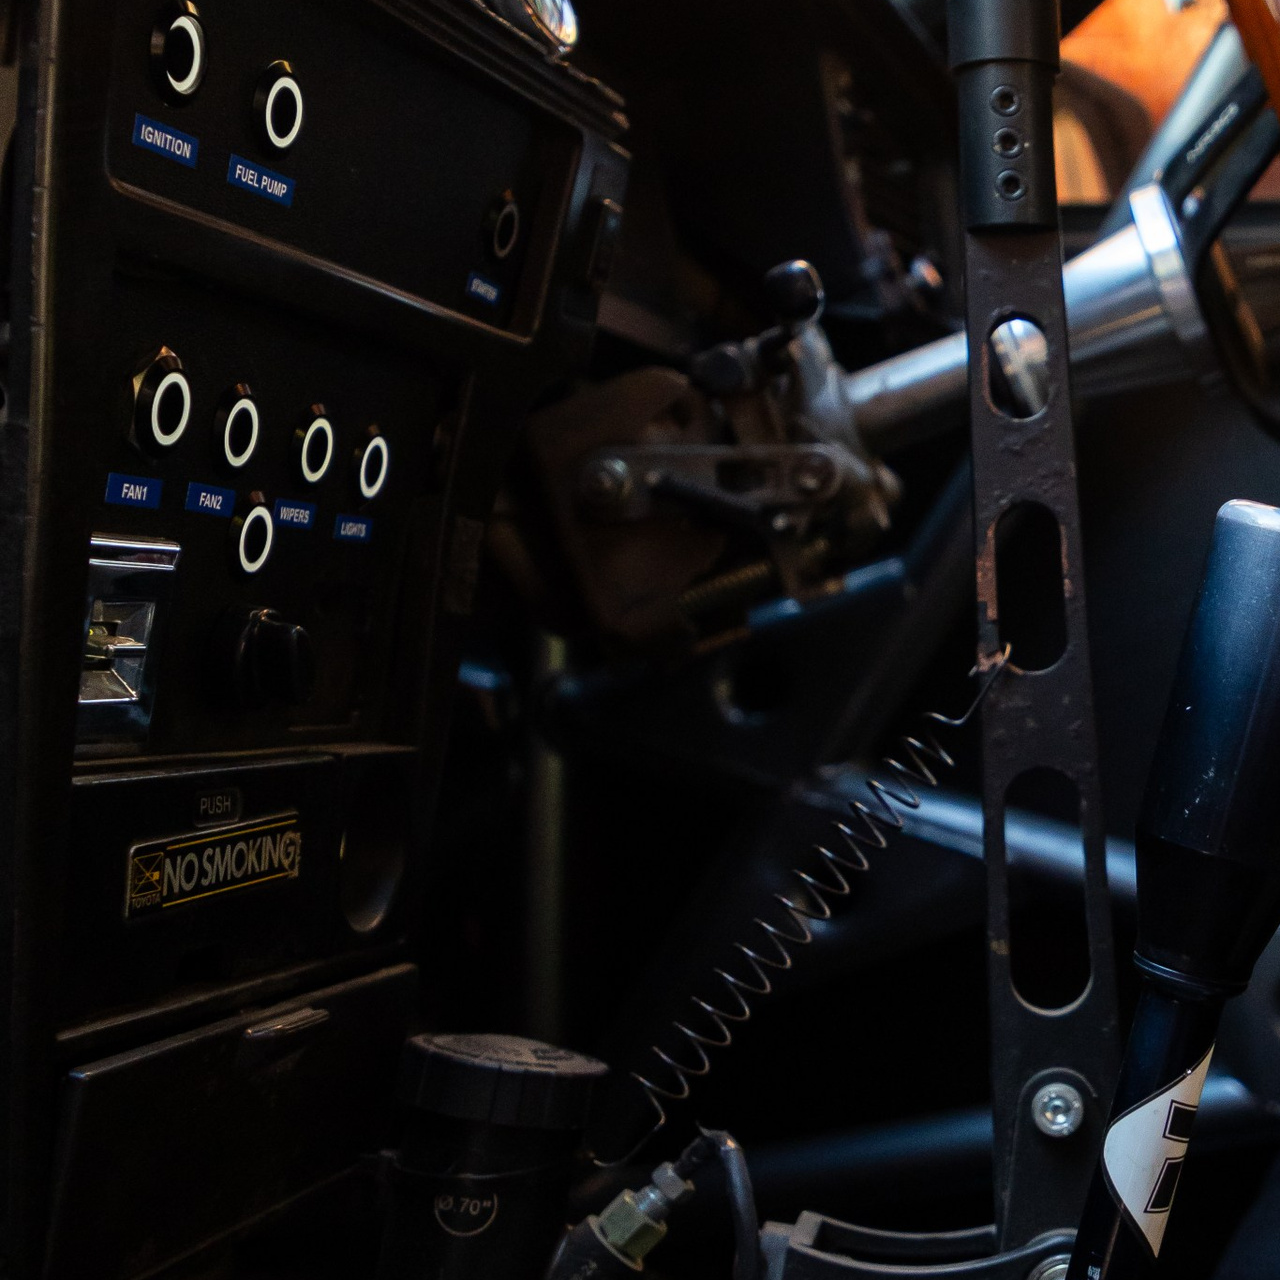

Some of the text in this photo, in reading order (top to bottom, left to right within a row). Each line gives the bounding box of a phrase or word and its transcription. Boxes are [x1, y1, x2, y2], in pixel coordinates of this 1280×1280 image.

[140, 124, 191, 159] IGNITION
[235, 164, 287, 197] FUEL PUMP
[121, 483, 148, 501] FAN1
[199, 492, 223, 510] FAN2
[280, 506, 310, 524] WIPERS
[340, 522, 366, 537] LIGHTS
[200, 796, 231, 814] PUSH
[162, 830, 299, 896] NO SMOKING
